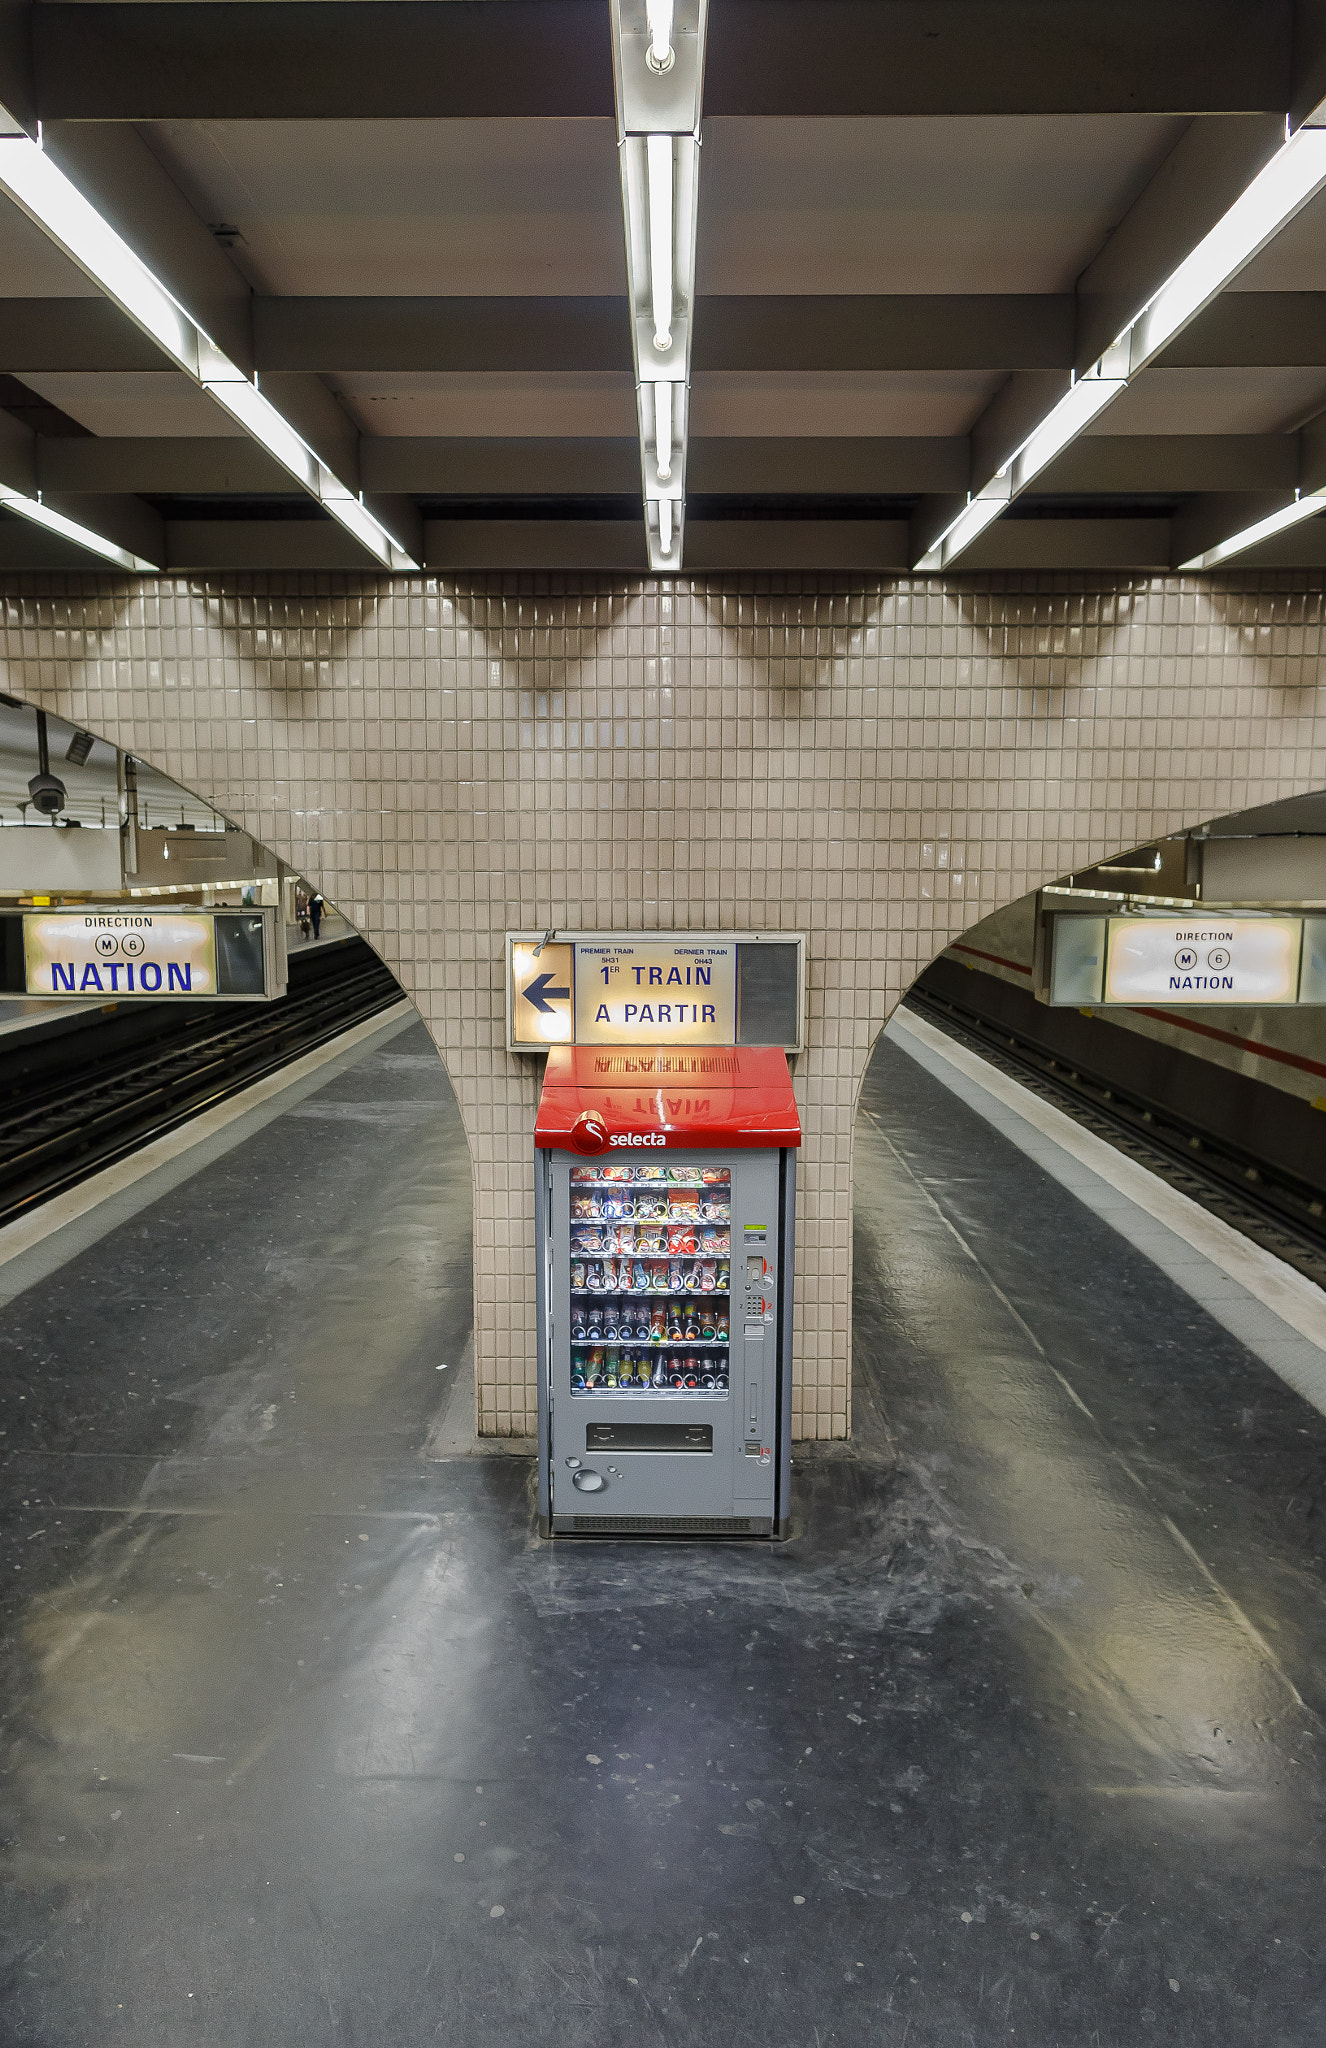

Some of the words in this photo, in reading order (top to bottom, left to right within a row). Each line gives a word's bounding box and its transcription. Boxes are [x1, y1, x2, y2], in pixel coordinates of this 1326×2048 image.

[85, 917, 153, 928] DIRECTION
[1175, 932, 1233, 941] DIRECTION
[580, 947, 611, 955] PREMIER
[614, 947, 634, 955] TRAIN
[674, 948, 705, 956] DERNIER
[707, 948, 728, 956] TRAIN
[50, 962, 192, 992] NATION
[631, 966, 711, 986] TRAIN
[1169, 976, 1233, 990] NATION
[595, 1004, 611, 1023] A
[624, 1004, 716, 1023] PARTIR
[609, 1132, 667, 1147] selecta
